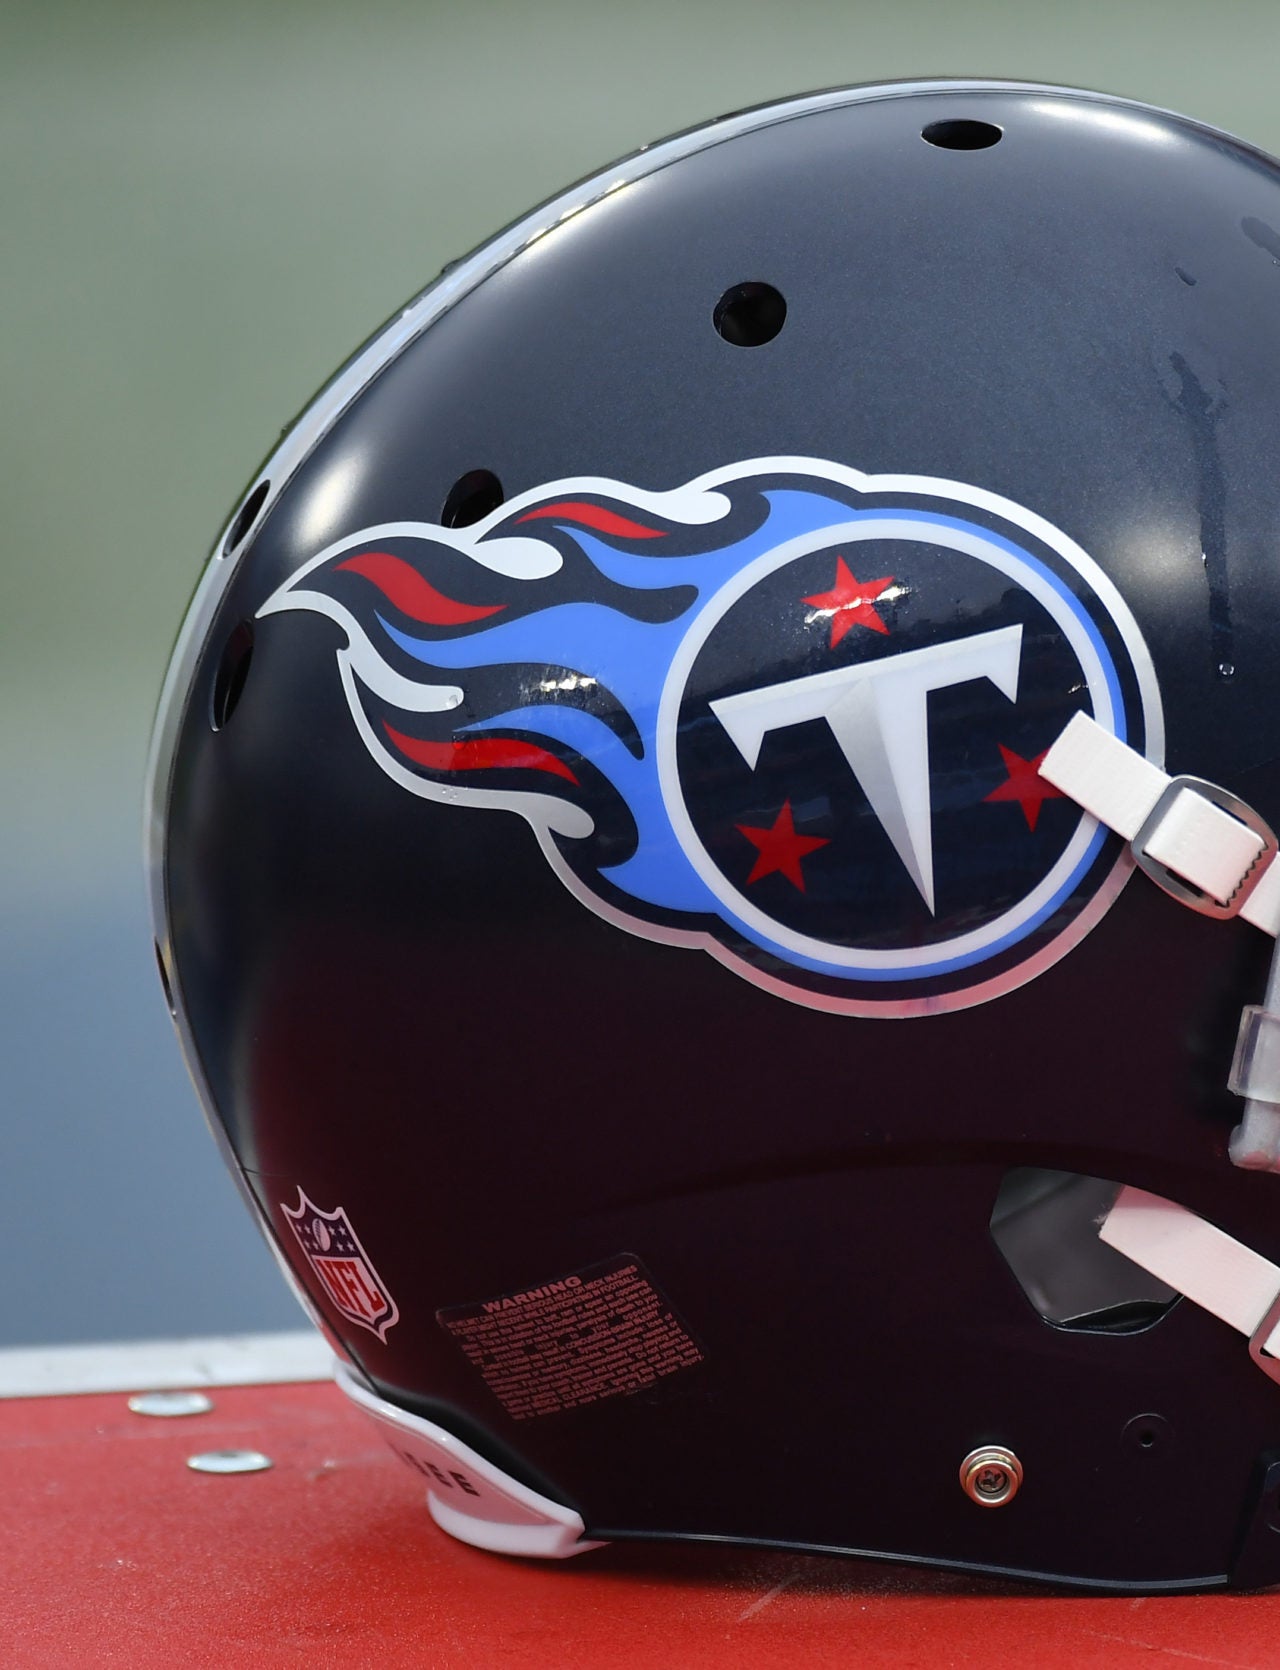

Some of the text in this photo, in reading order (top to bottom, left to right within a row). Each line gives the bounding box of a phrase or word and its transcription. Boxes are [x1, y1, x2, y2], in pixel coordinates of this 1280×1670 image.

[708, 623, 1023, 918] T
[316, 1258, 385, 1318] NFL
[482, 1276, 582, 1313] WARNING
